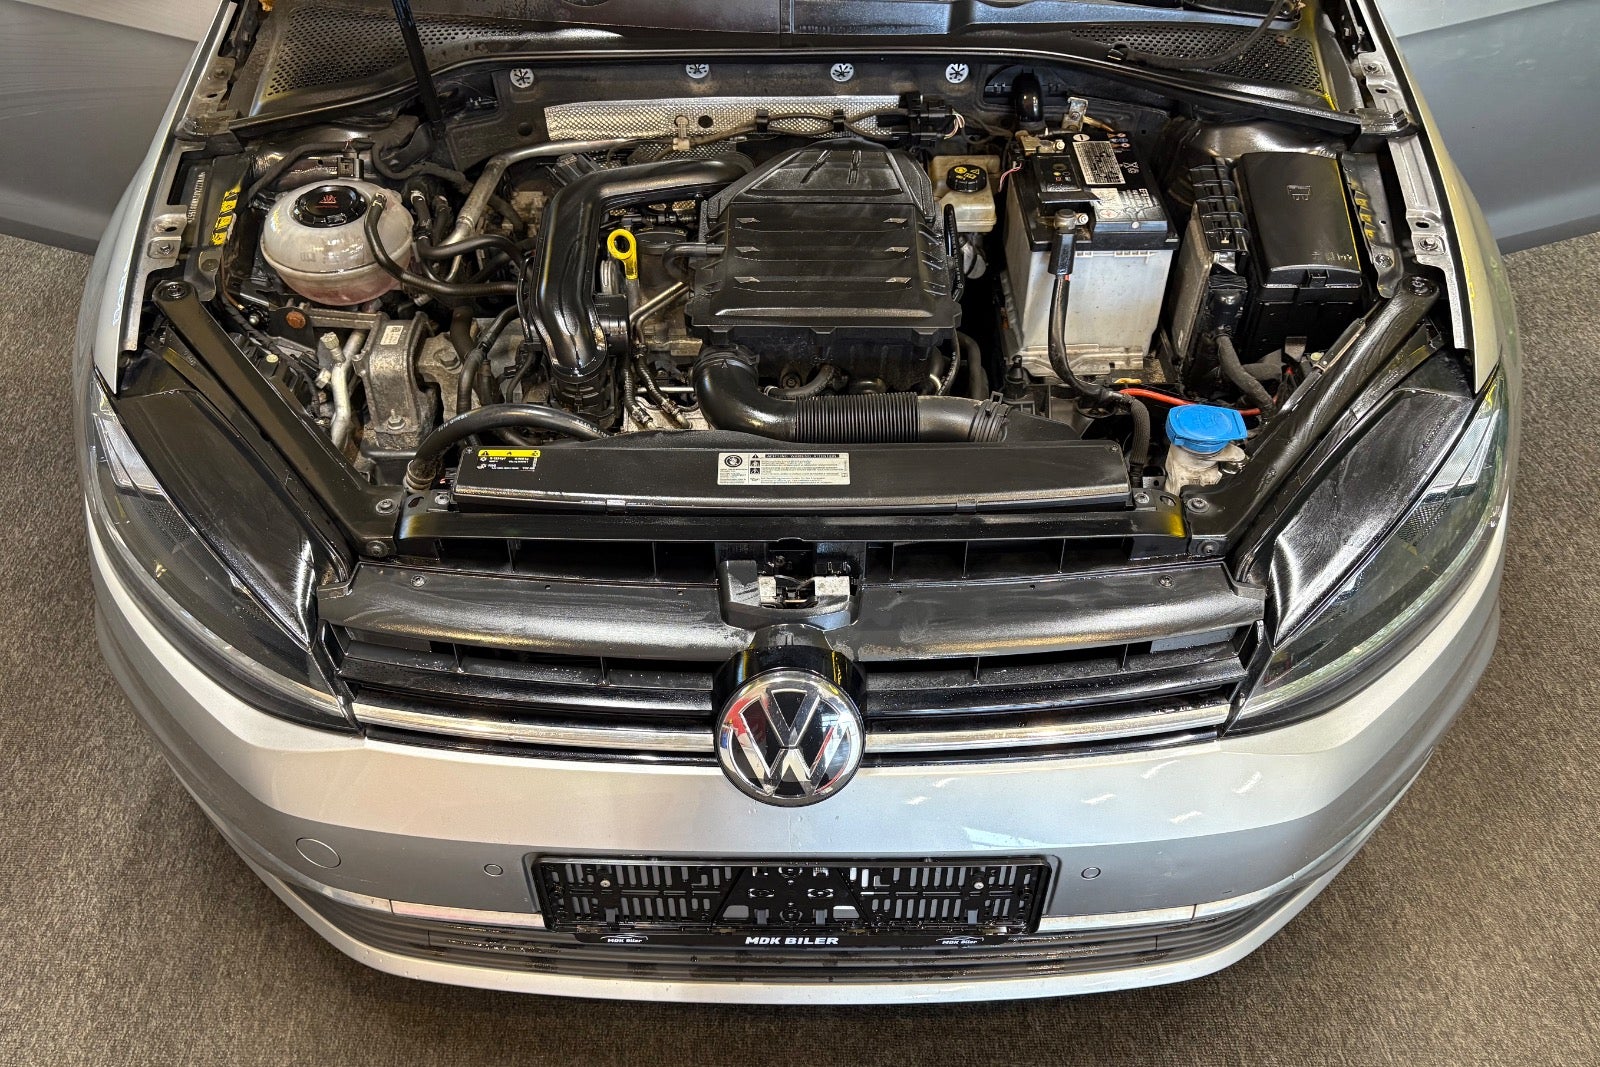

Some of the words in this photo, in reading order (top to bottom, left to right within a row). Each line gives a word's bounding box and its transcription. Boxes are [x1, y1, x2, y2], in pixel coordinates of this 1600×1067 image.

[719, 677, 855, 799] VW
[745, 936, 781, 945] MDK
[784, 936, 839, 945] BILER
